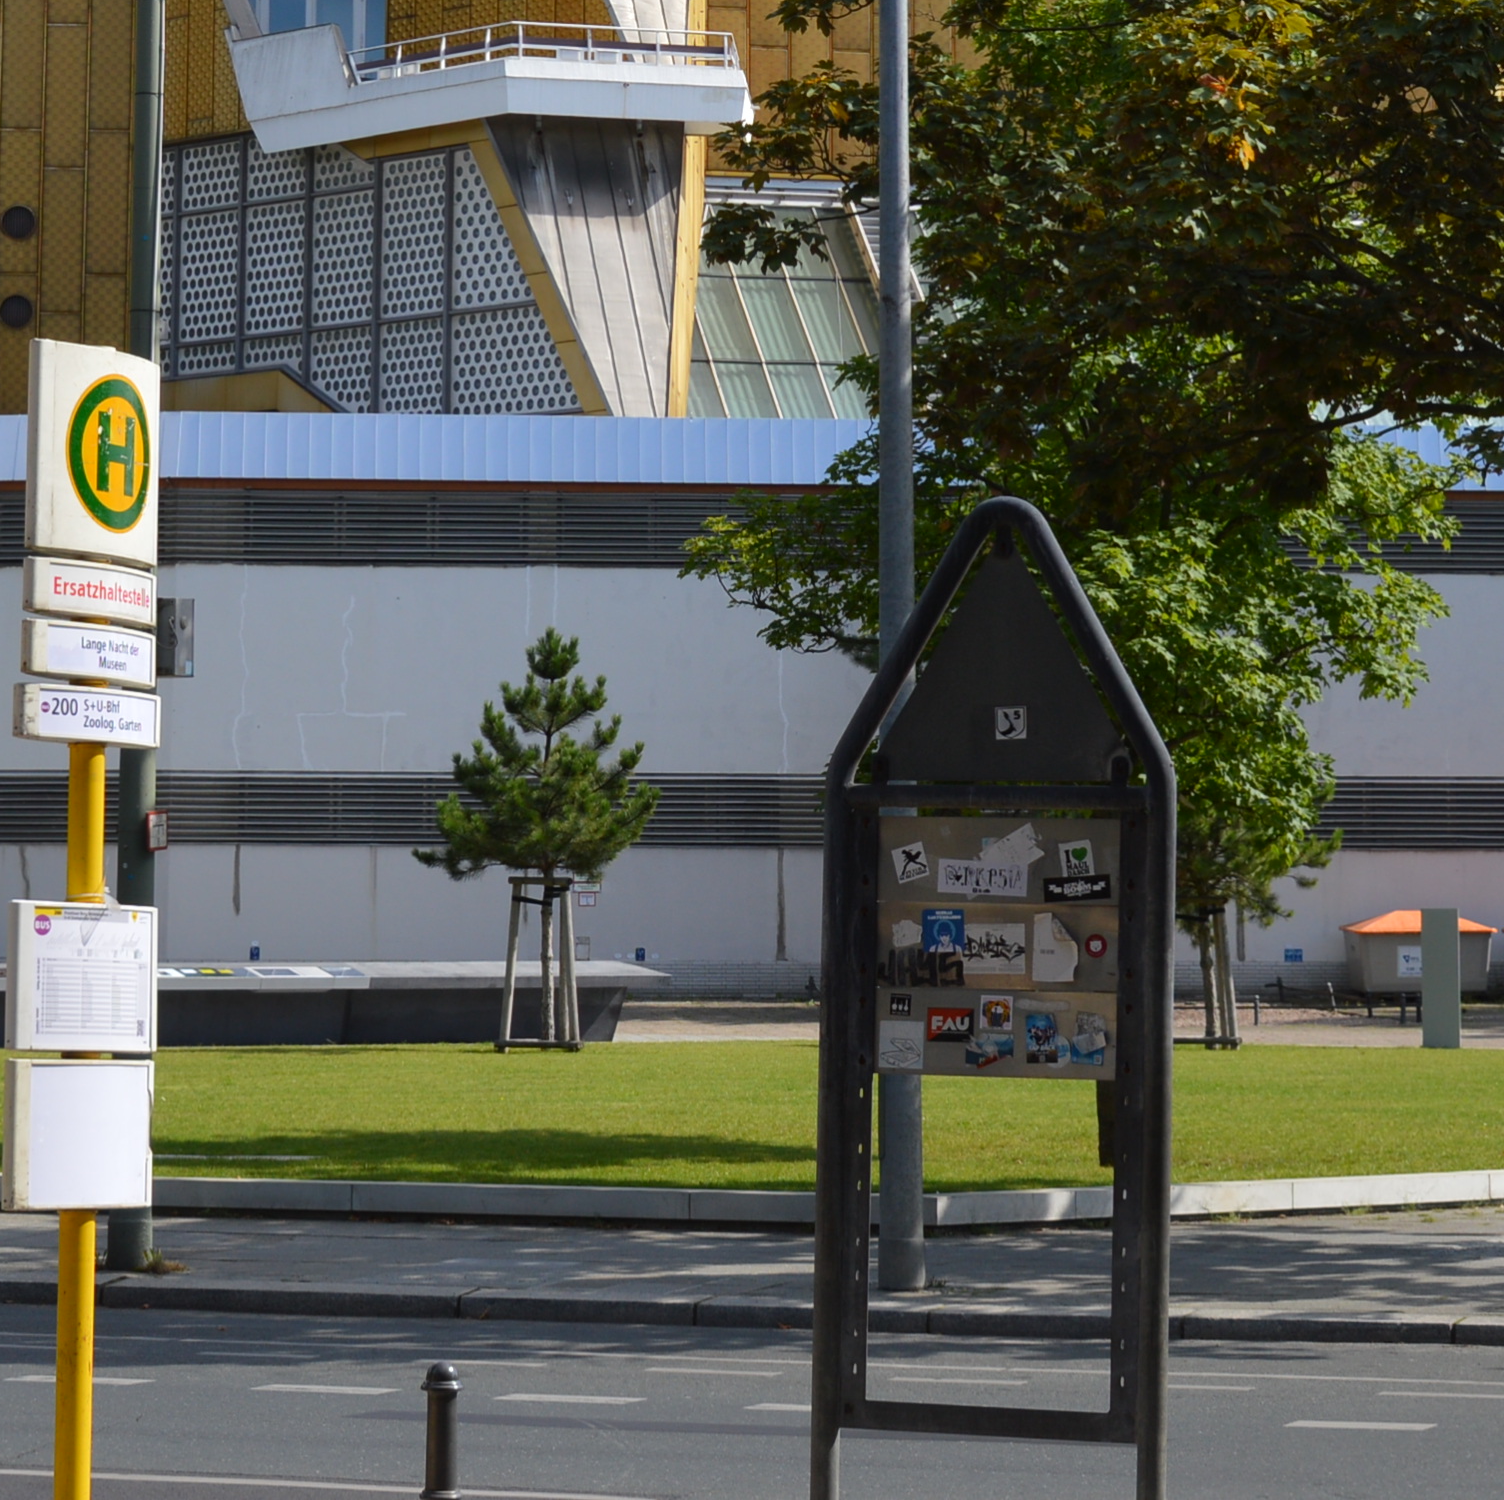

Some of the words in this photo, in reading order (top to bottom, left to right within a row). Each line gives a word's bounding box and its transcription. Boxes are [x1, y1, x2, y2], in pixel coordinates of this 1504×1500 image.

[97, 410, 134, 497] H
[53, 576, 150, 608] Ersatzhaltestelle
[81, 636, 106, 654] Lange
[108, 639, 128, 654] Nacht
[130, 644, 139, 656] der
[98, 656, 127, 671] Museen
[51, 697, 78, 716] 200
[83, 699, 120, 714] S+U-Bhf
[83, 715, 116, 733] Zoolog.
[118, 717, 142, 732] Garten
[35, 920, 51, 930] BUS
[931, 1015, 970, 1031] FAU
